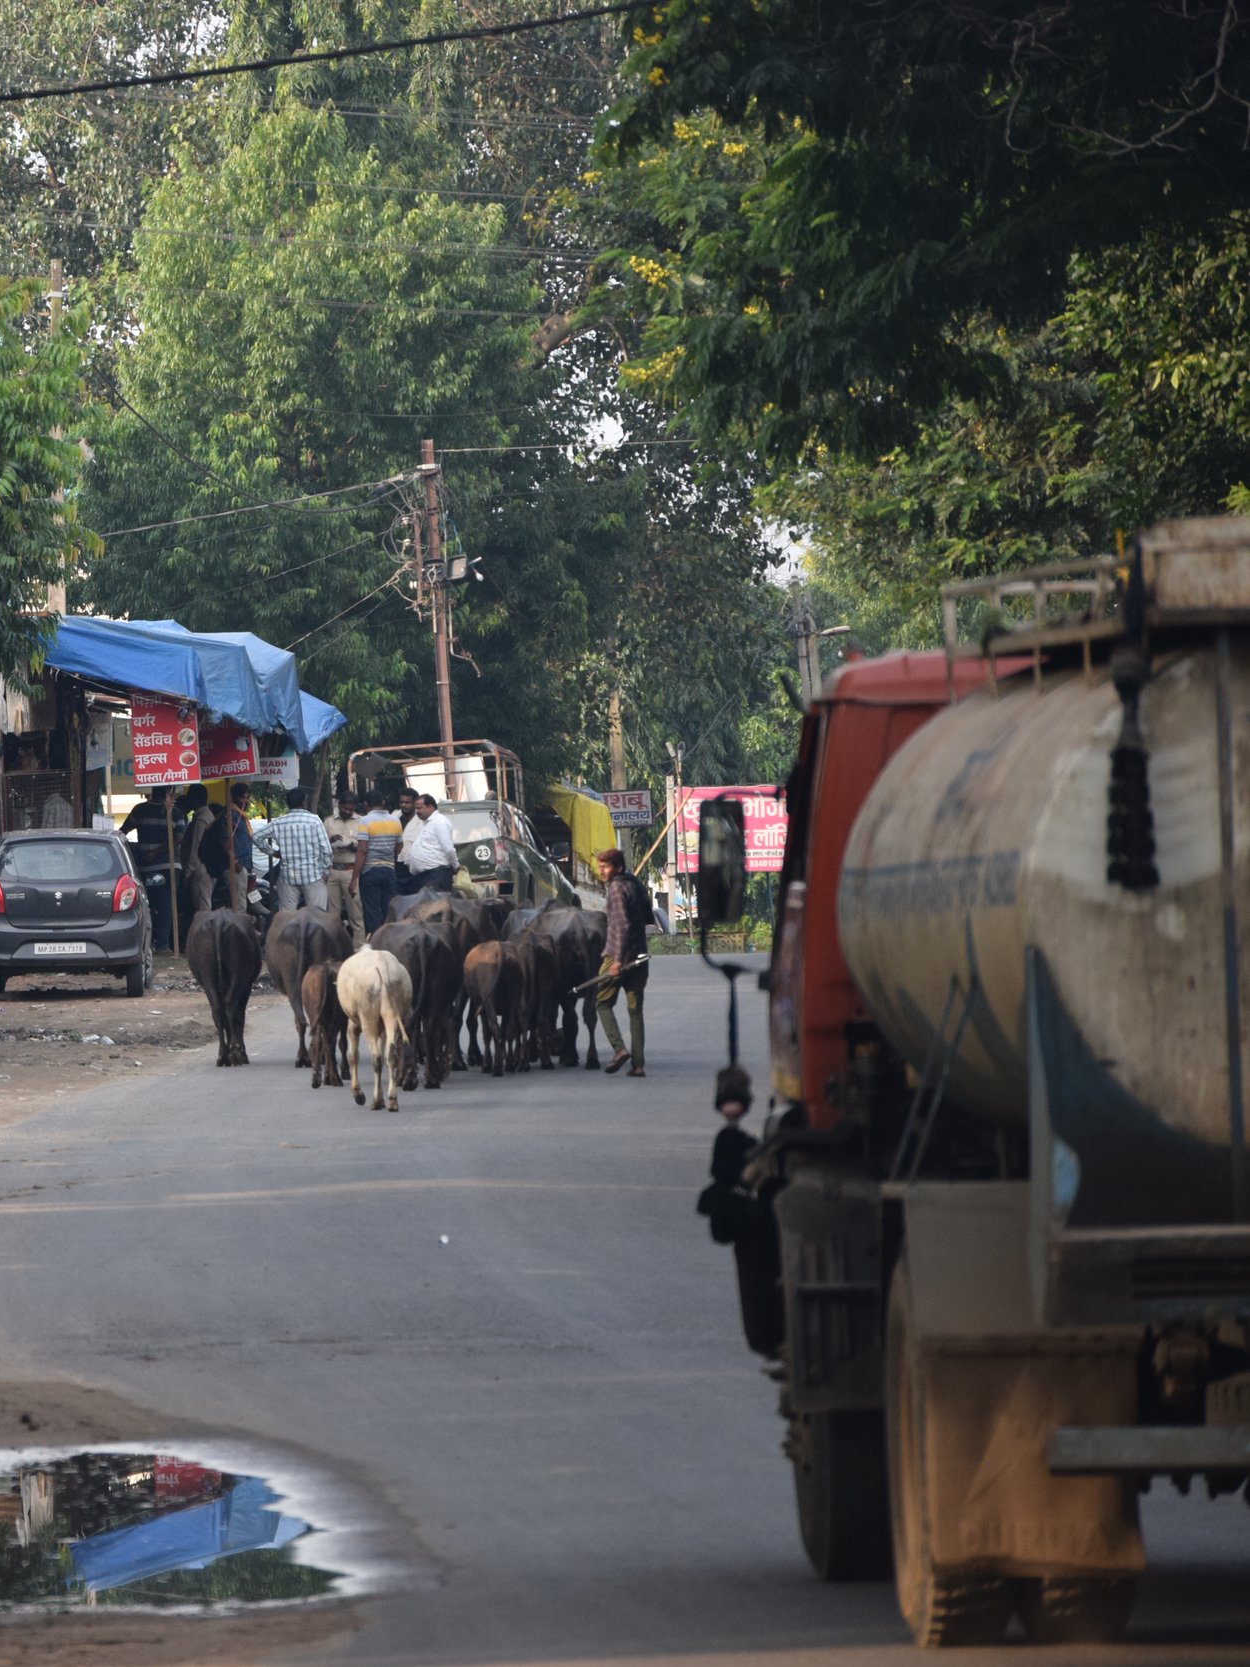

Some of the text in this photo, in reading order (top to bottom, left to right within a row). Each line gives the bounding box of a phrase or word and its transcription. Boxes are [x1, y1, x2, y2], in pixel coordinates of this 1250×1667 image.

[133, 713, 156, 727] बर्गर
[135, 753, 167, 769] नूडल्स
[477, 849, 489, 858] 23
